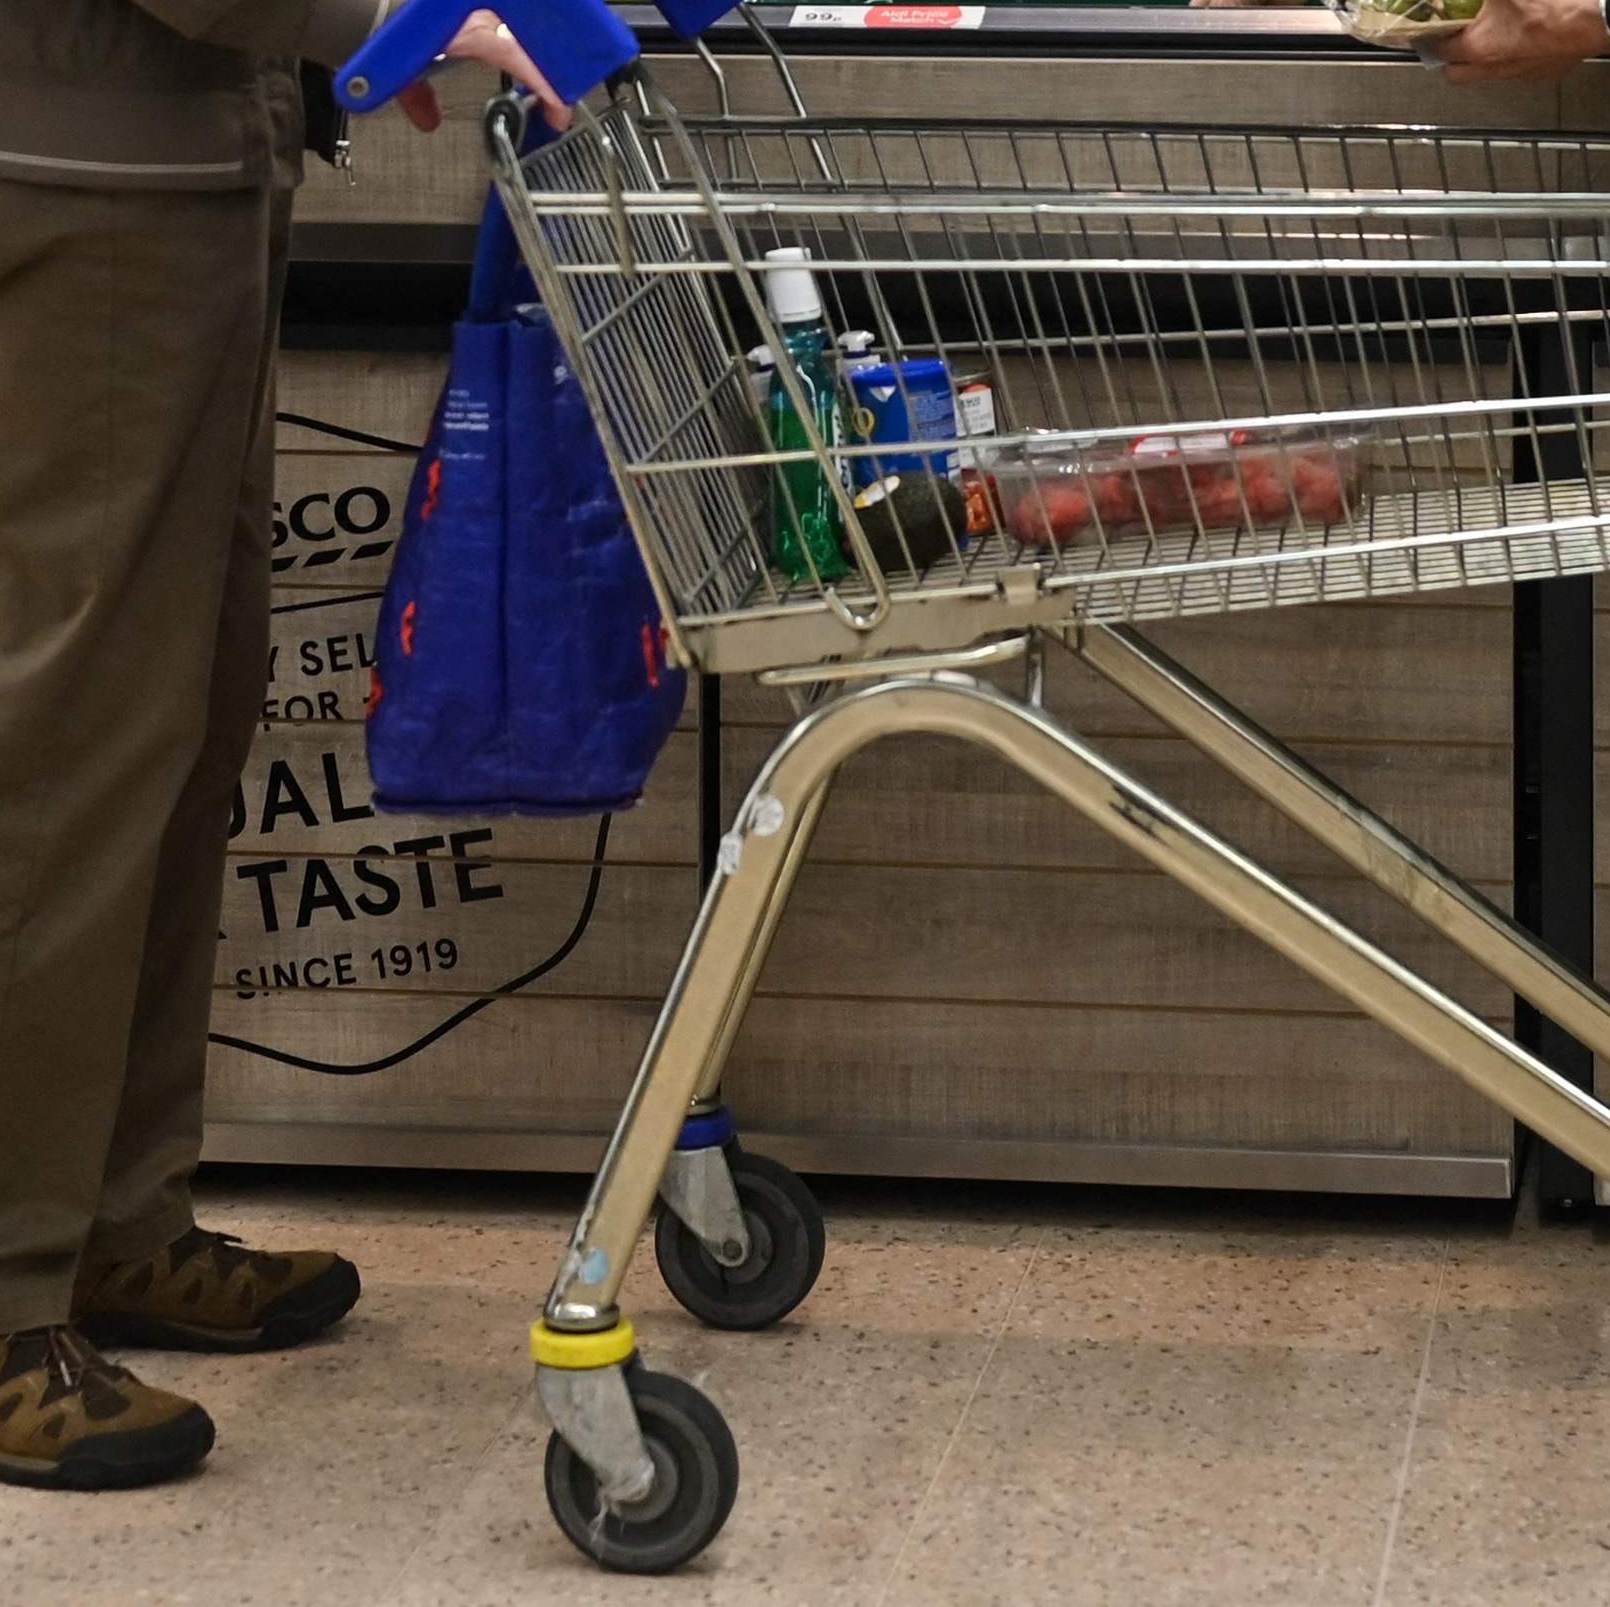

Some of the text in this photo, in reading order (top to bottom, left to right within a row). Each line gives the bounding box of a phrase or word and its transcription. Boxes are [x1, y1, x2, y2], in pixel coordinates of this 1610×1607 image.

[262, 691, 344, 732] FOR
[236, 827, 504, 933] TASTE
[236, 938, 458, 999] SINCE 1919
